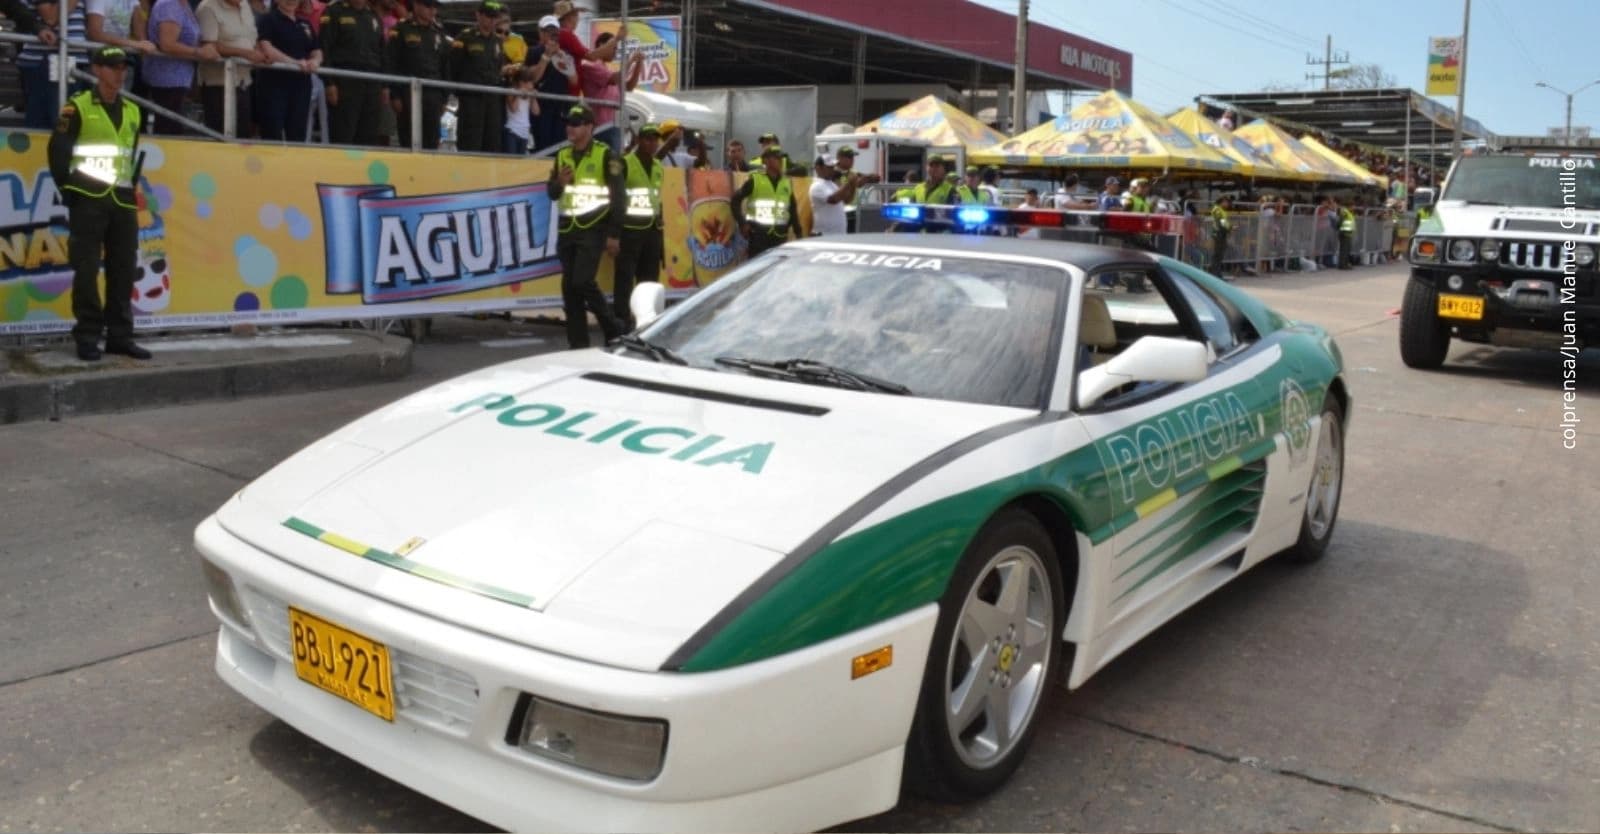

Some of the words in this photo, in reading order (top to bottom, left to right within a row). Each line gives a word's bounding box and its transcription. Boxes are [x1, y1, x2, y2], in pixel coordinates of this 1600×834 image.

[1061, 45, 1079, 68] KIA
[1060, 117, 1123, 132] AGUILA
[810, 251, 942, 271] POLICIA
[448, 391, 775, 475] POLICIA
[1105, 391, 1257, 505] POLICIA
